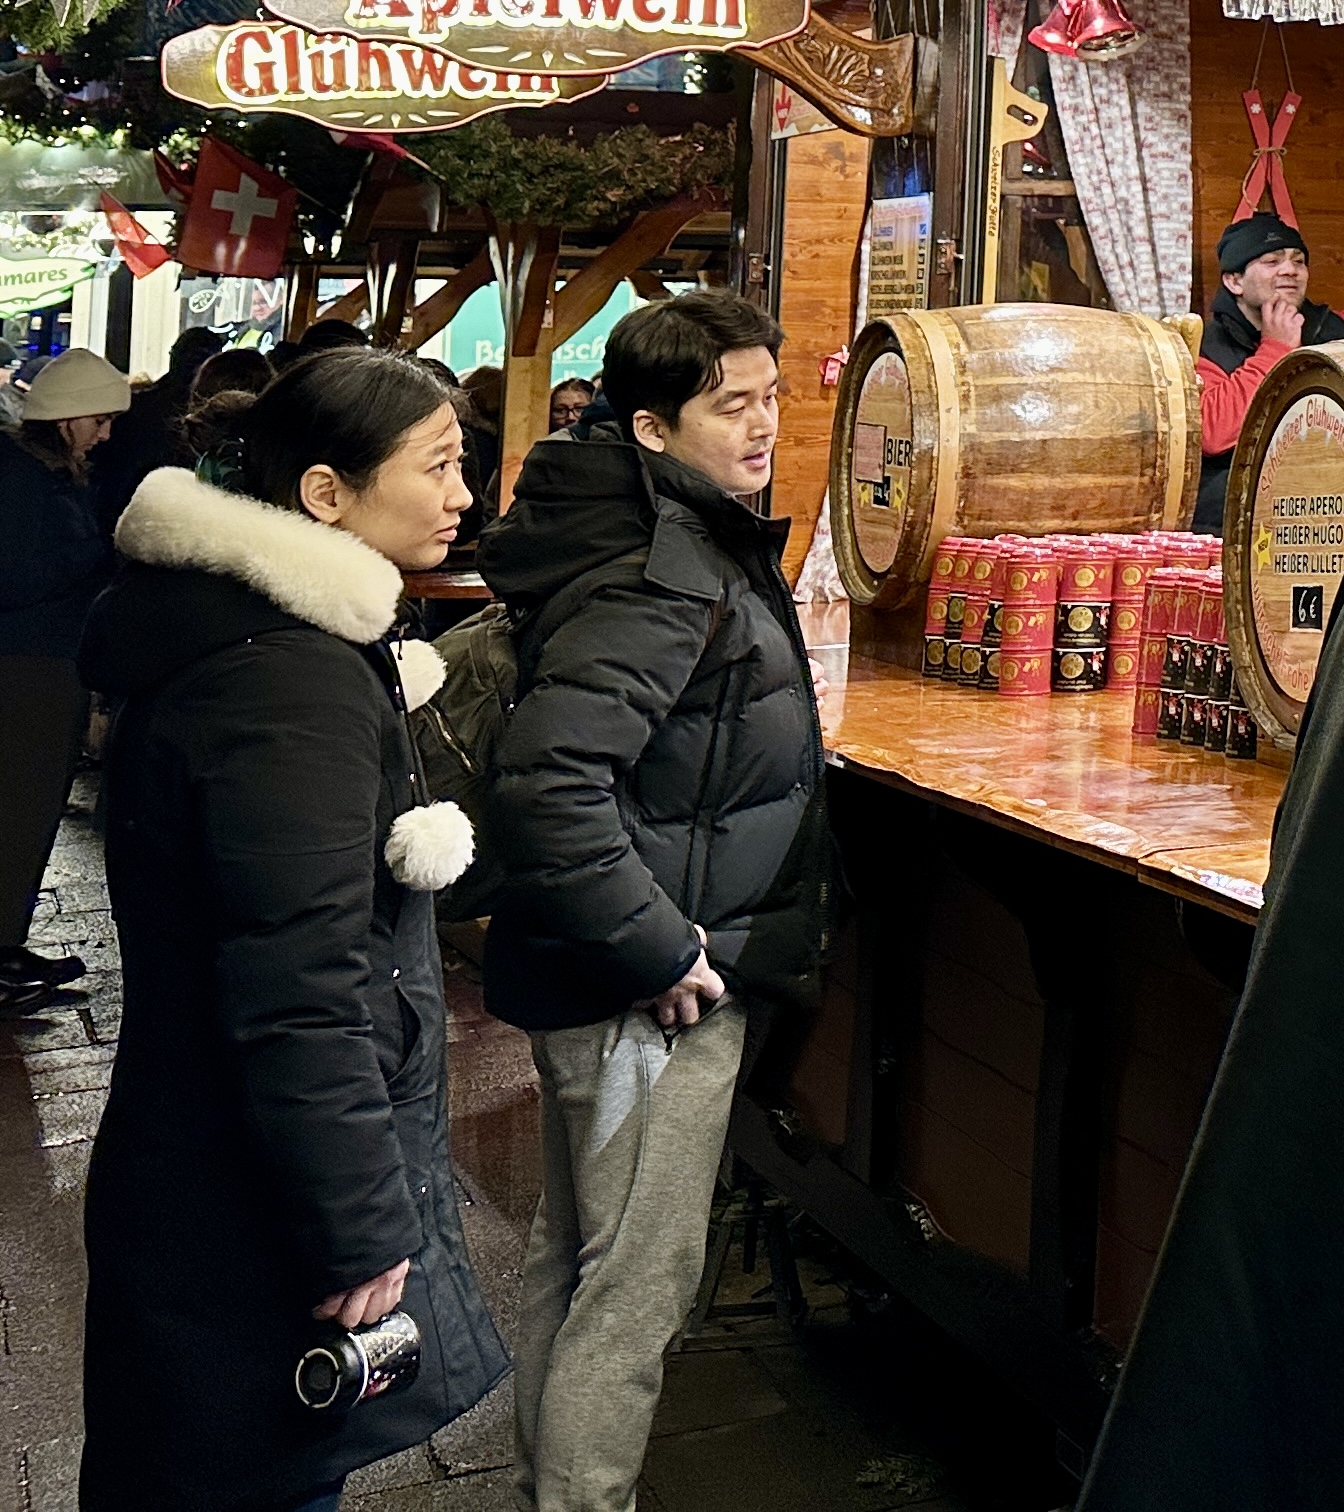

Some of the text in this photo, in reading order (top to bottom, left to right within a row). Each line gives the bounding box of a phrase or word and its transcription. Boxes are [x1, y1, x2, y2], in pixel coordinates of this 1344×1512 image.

[887, 438, 912, 467] BIER
[1312, 524, 1344, 545] HUGO
[1311, 554, 1343, 574] LILLET
[1298, 589, 1317, 623] 6€
